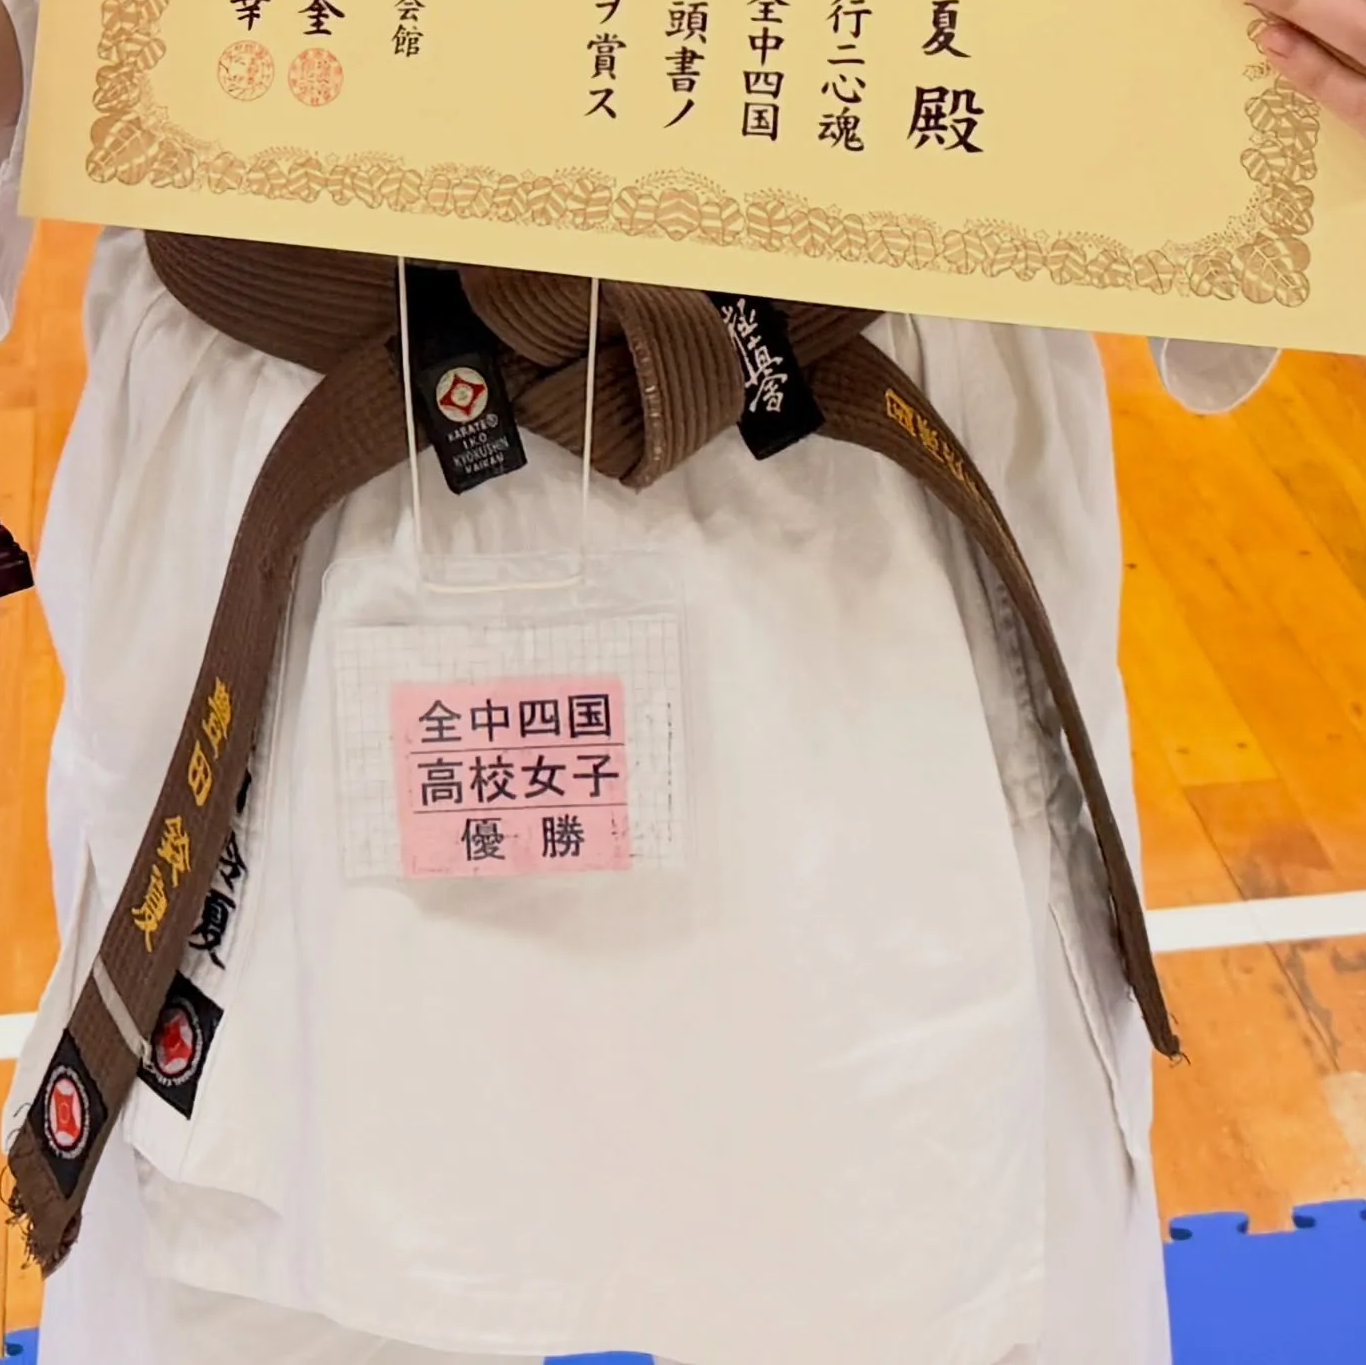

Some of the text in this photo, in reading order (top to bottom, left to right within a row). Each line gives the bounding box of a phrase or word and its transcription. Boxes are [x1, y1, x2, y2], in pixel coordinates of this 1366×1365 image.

[417, 693, 612, 744] 全中四国
[417, 753, 620, 807] 高校女子
